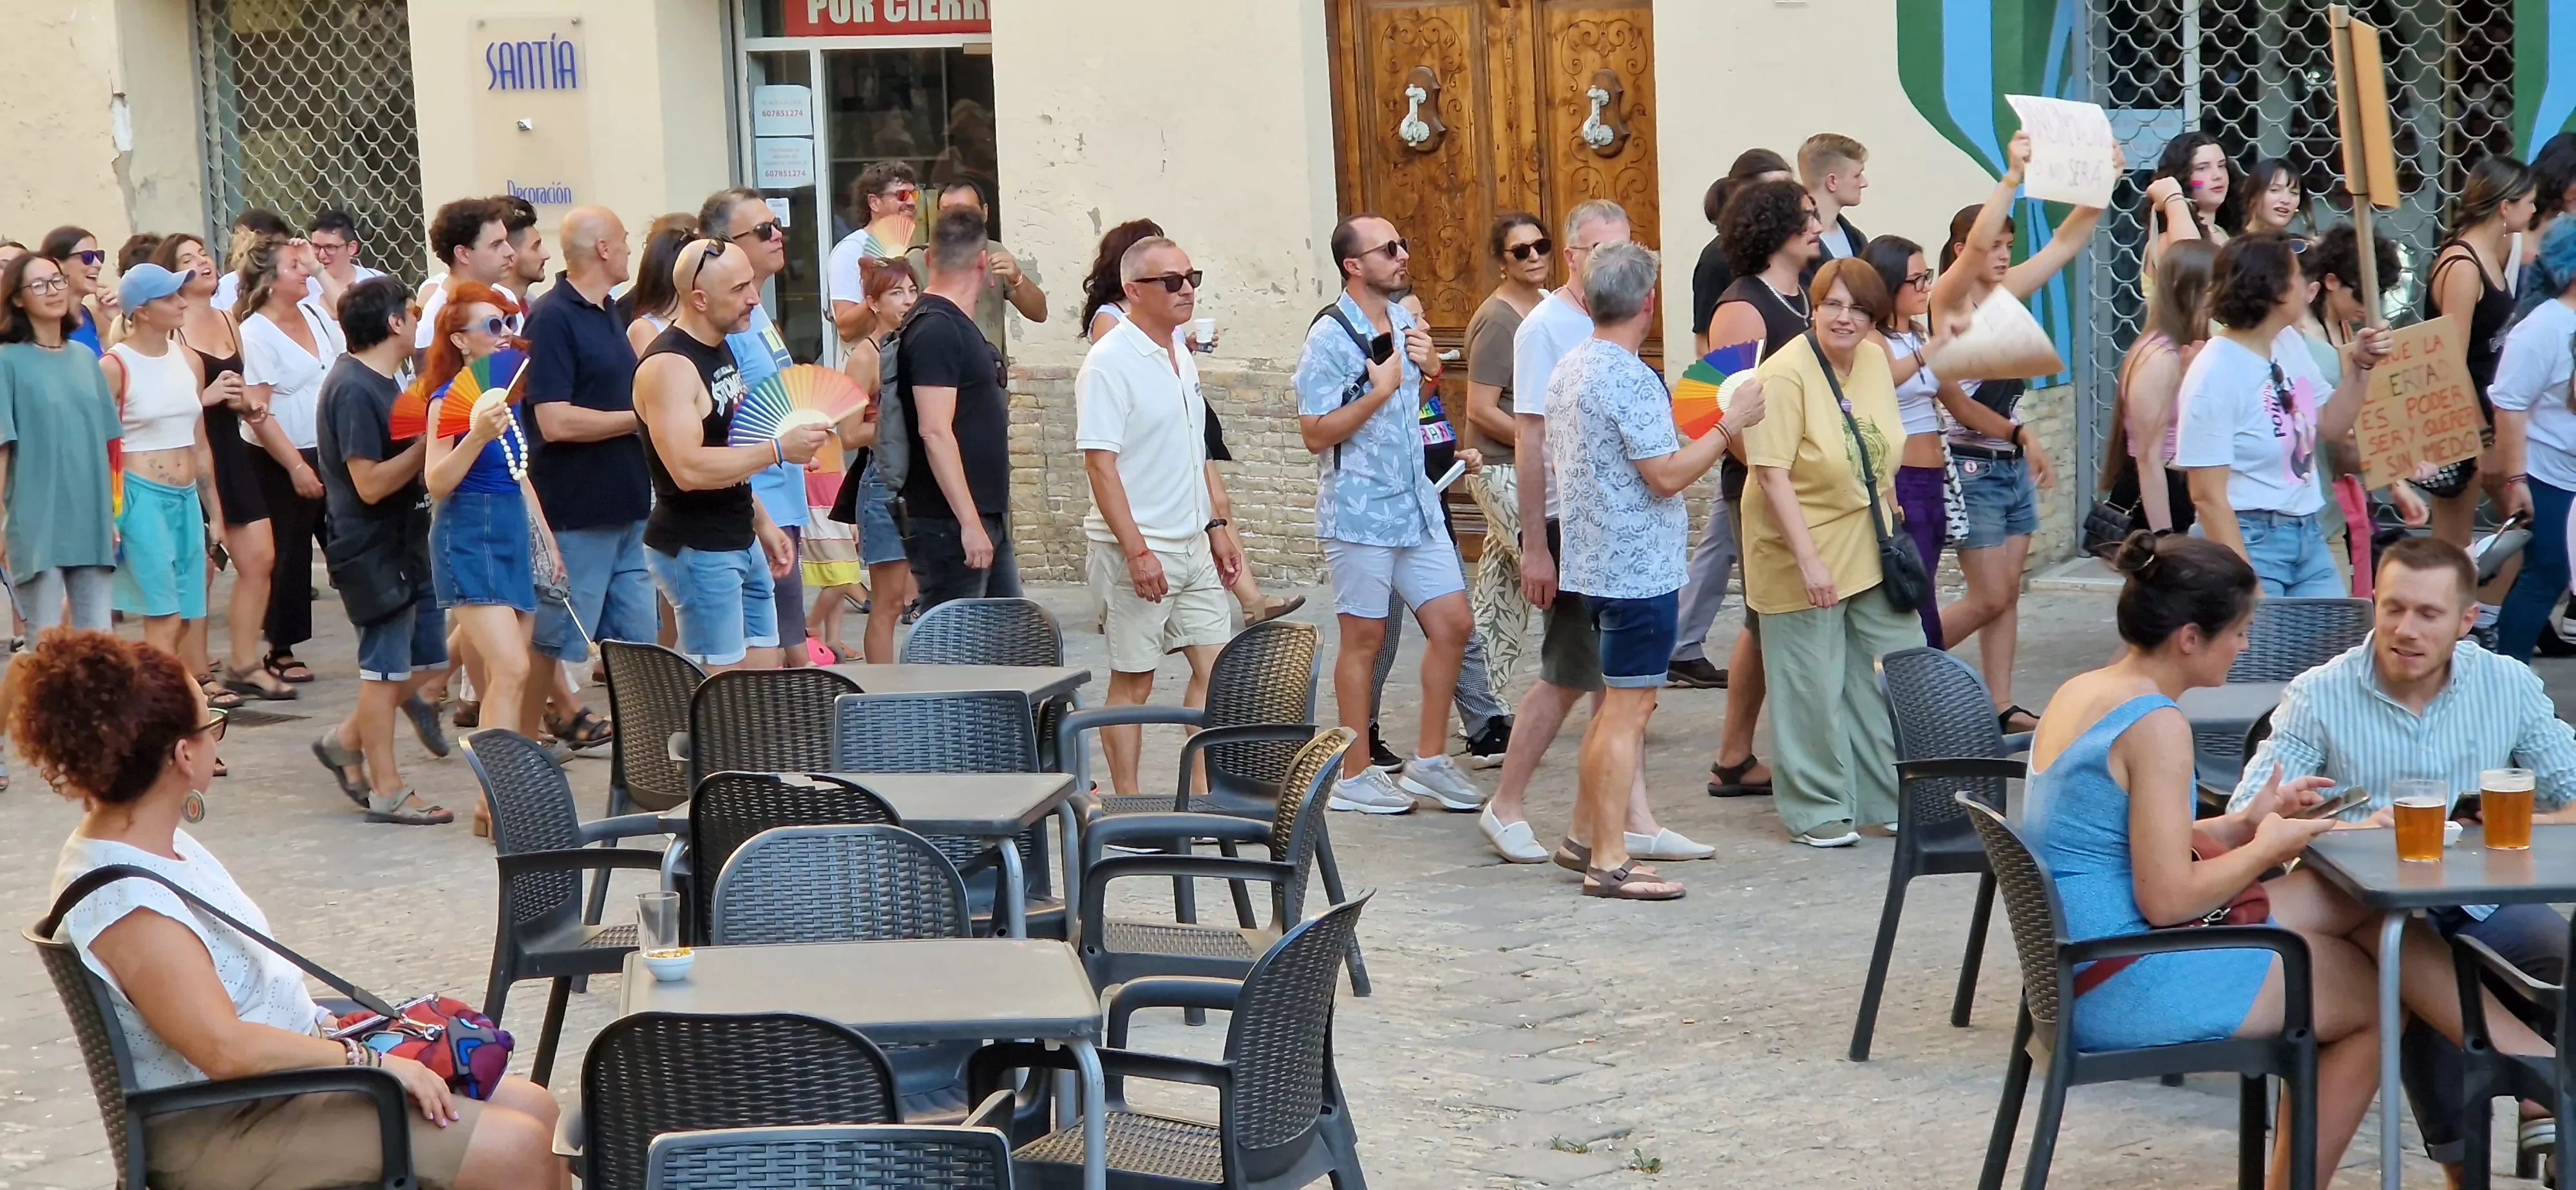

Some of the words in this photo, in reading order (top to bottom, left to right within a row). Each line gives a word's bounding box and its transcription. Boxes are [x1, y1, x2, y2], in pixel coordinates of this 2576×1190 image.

[808, 0, 875, 24] POR
[884, 0, 990, 22] CIERR
[486, 33, 576, 90] SANTÍA
[762, 109, 803, 117] 607851274
[507, 180, 572, 203] Decoración
[2423, 334, 2445, 355] LA
[2362, 407, 2390, 431] ES
[2405, 384, 2465, 419] PODER
[1420, 424, 1455, 440] RANS
[2369, 430, 2405, 456] SER
